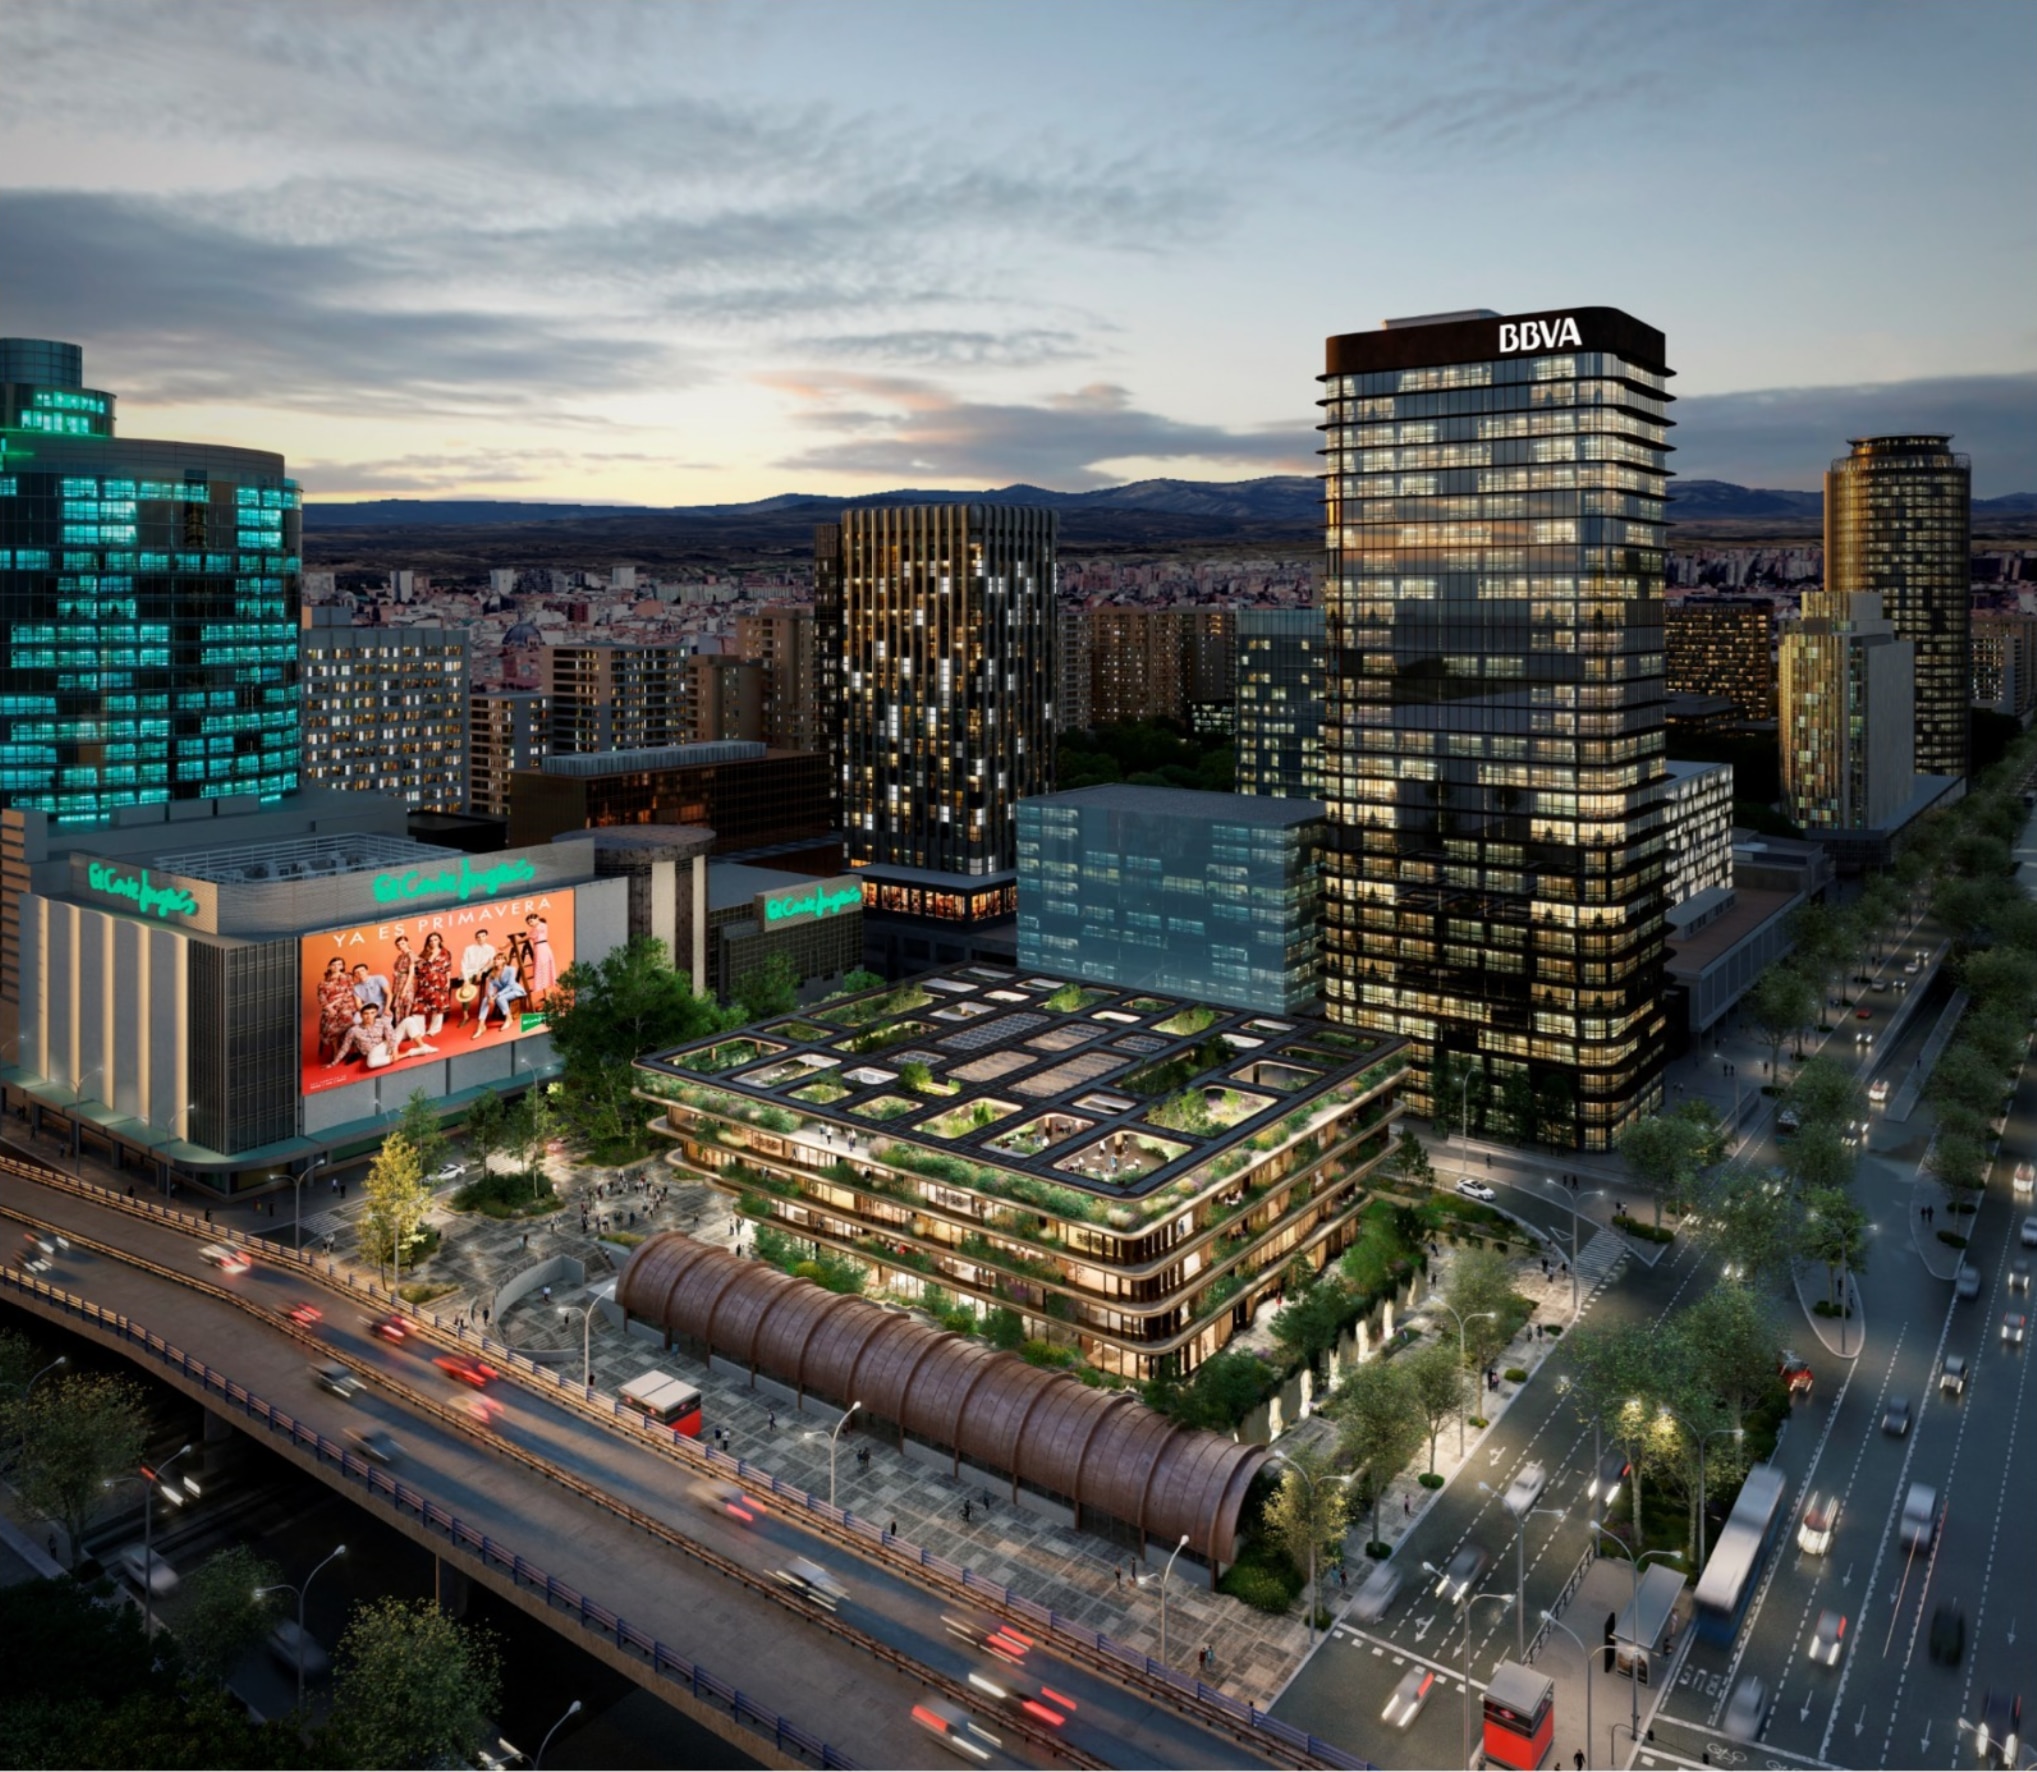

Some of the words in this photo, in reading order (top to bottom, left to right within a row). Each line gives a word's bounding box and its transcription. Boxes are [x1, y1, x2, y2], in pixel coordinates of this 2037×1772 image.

[1499, 317, 1583, 353] BBVA
[333, 931, 365, 948] YA
[379, 923, 404, 940] ES
[418, 897, 551, 933] PRIMAVERA
